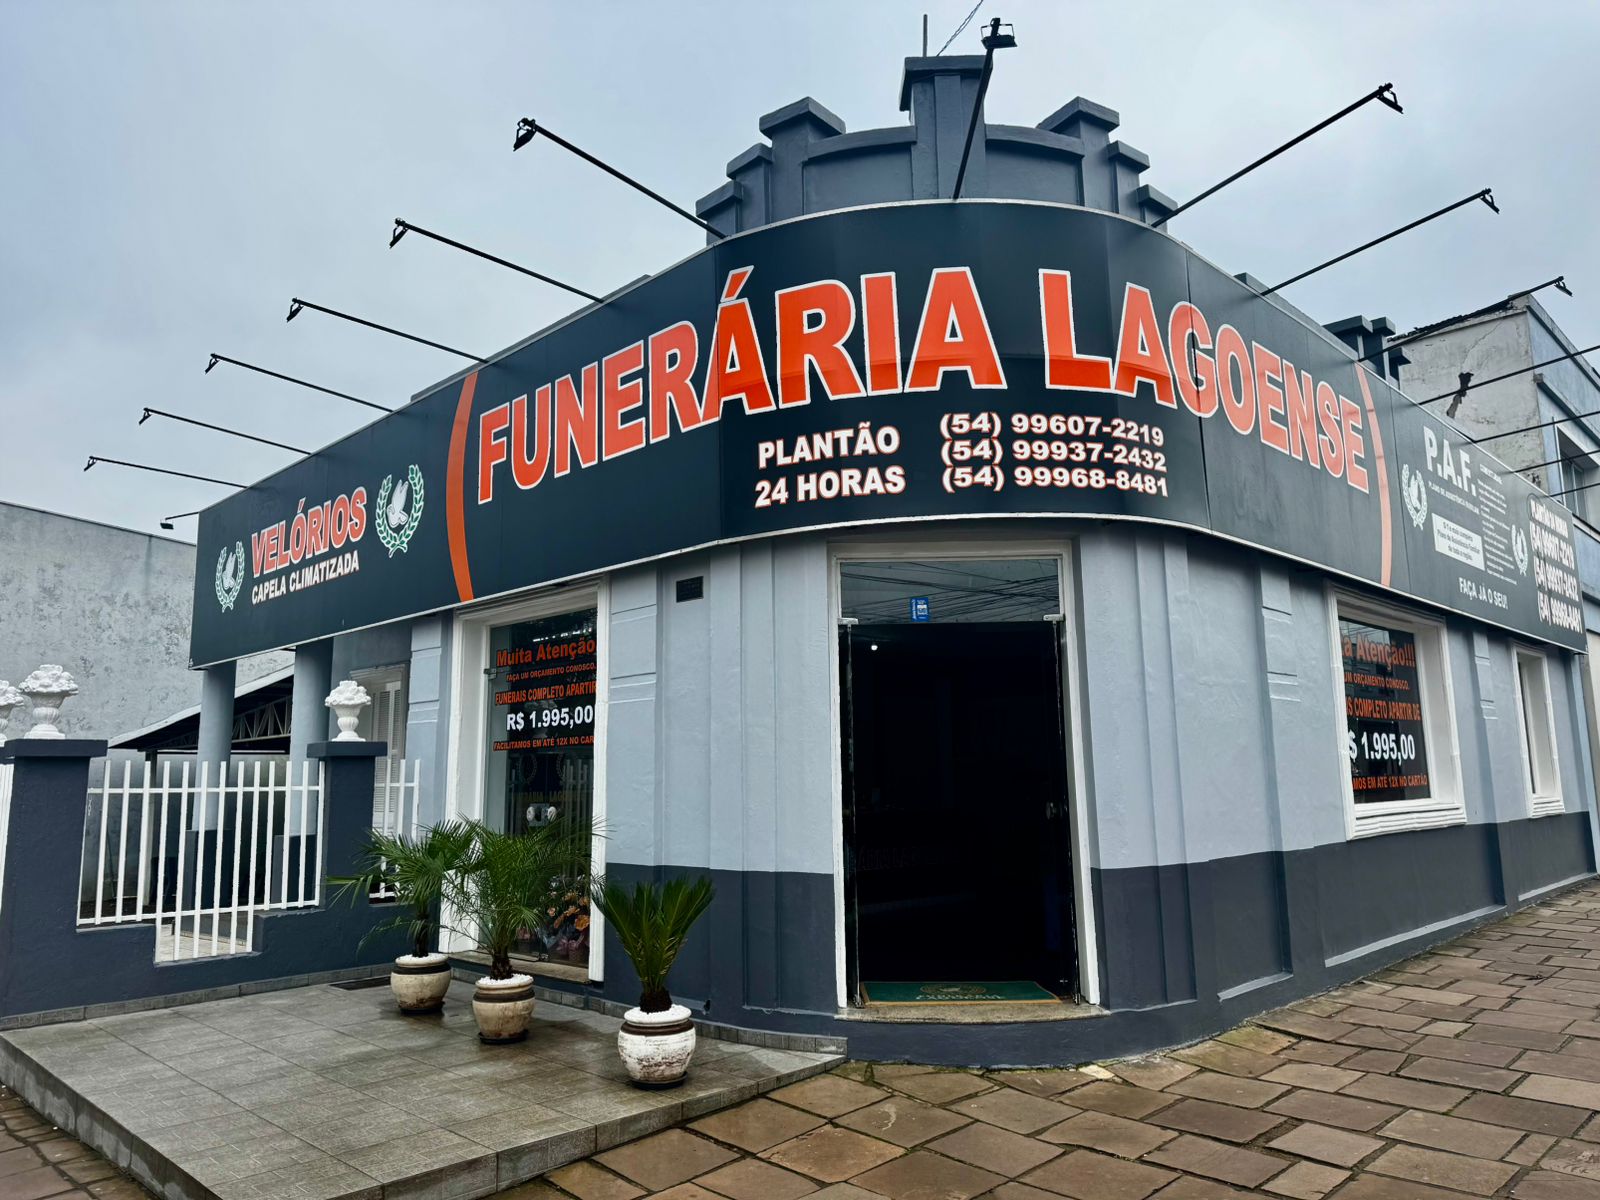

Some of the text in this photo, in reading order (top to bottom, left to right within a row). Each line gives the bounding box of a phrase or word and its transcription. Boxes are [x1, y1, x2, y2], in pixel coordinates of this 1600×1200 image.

[478, 265, 1369, 504] FUNERÁRIA LAGOENSE
[758, 421, 900, 468] PLANTÃO
[940, 412, 1164, 447] (54) 99607-2219
[941, 439, 1167, 471] (54) 99937-2432
[1423, 425, 1477, 497] P.A.F.
[755, 464, 906, 508] 24 HORAS
[942, 465, 1168, 497] (54) 99968-8481
[251, 486, 367, 578] VELÓRIOS
[252, 550, 360, 605] CAPELA CLIMATIZADA
[1459, 576, 1478, 601] FAÇA
[1487, 588, 1493, 604] O
[496, 636, 596, 667] Muita Atenção
[1356, 631, 1415, 672] Atenção!!!
[521, 671, 529, 679] UM
[530, 665, 564, 680] ORÇAMENTO
[1353, 672, 1385, 687] ORÇAMENTO
[495, 690, 527, 705] FUNERAIS
[528, 684, 565, 700] COMPLETO
[1354, 697, 1388, 719] COMPLETO
[1388, 701, 1412, 720] APARTIR
[1412, 703, 1421, 720] DE
[506, 705, 594, 731] R$ 1.995,00
[532, 739, 542, 748] EM
[543, 736, 555, 747] ATÉ
[556, 737, 568, 746] 12X
[569, 736, 579, 745] NO
[1361, 731, 1416, 767] 1.995,00
[1367, 775, 1377, 789] EM
[1377, 773, 1388, 788] ATÉ
[1407, 772, 1427, 786] CARTÃO
